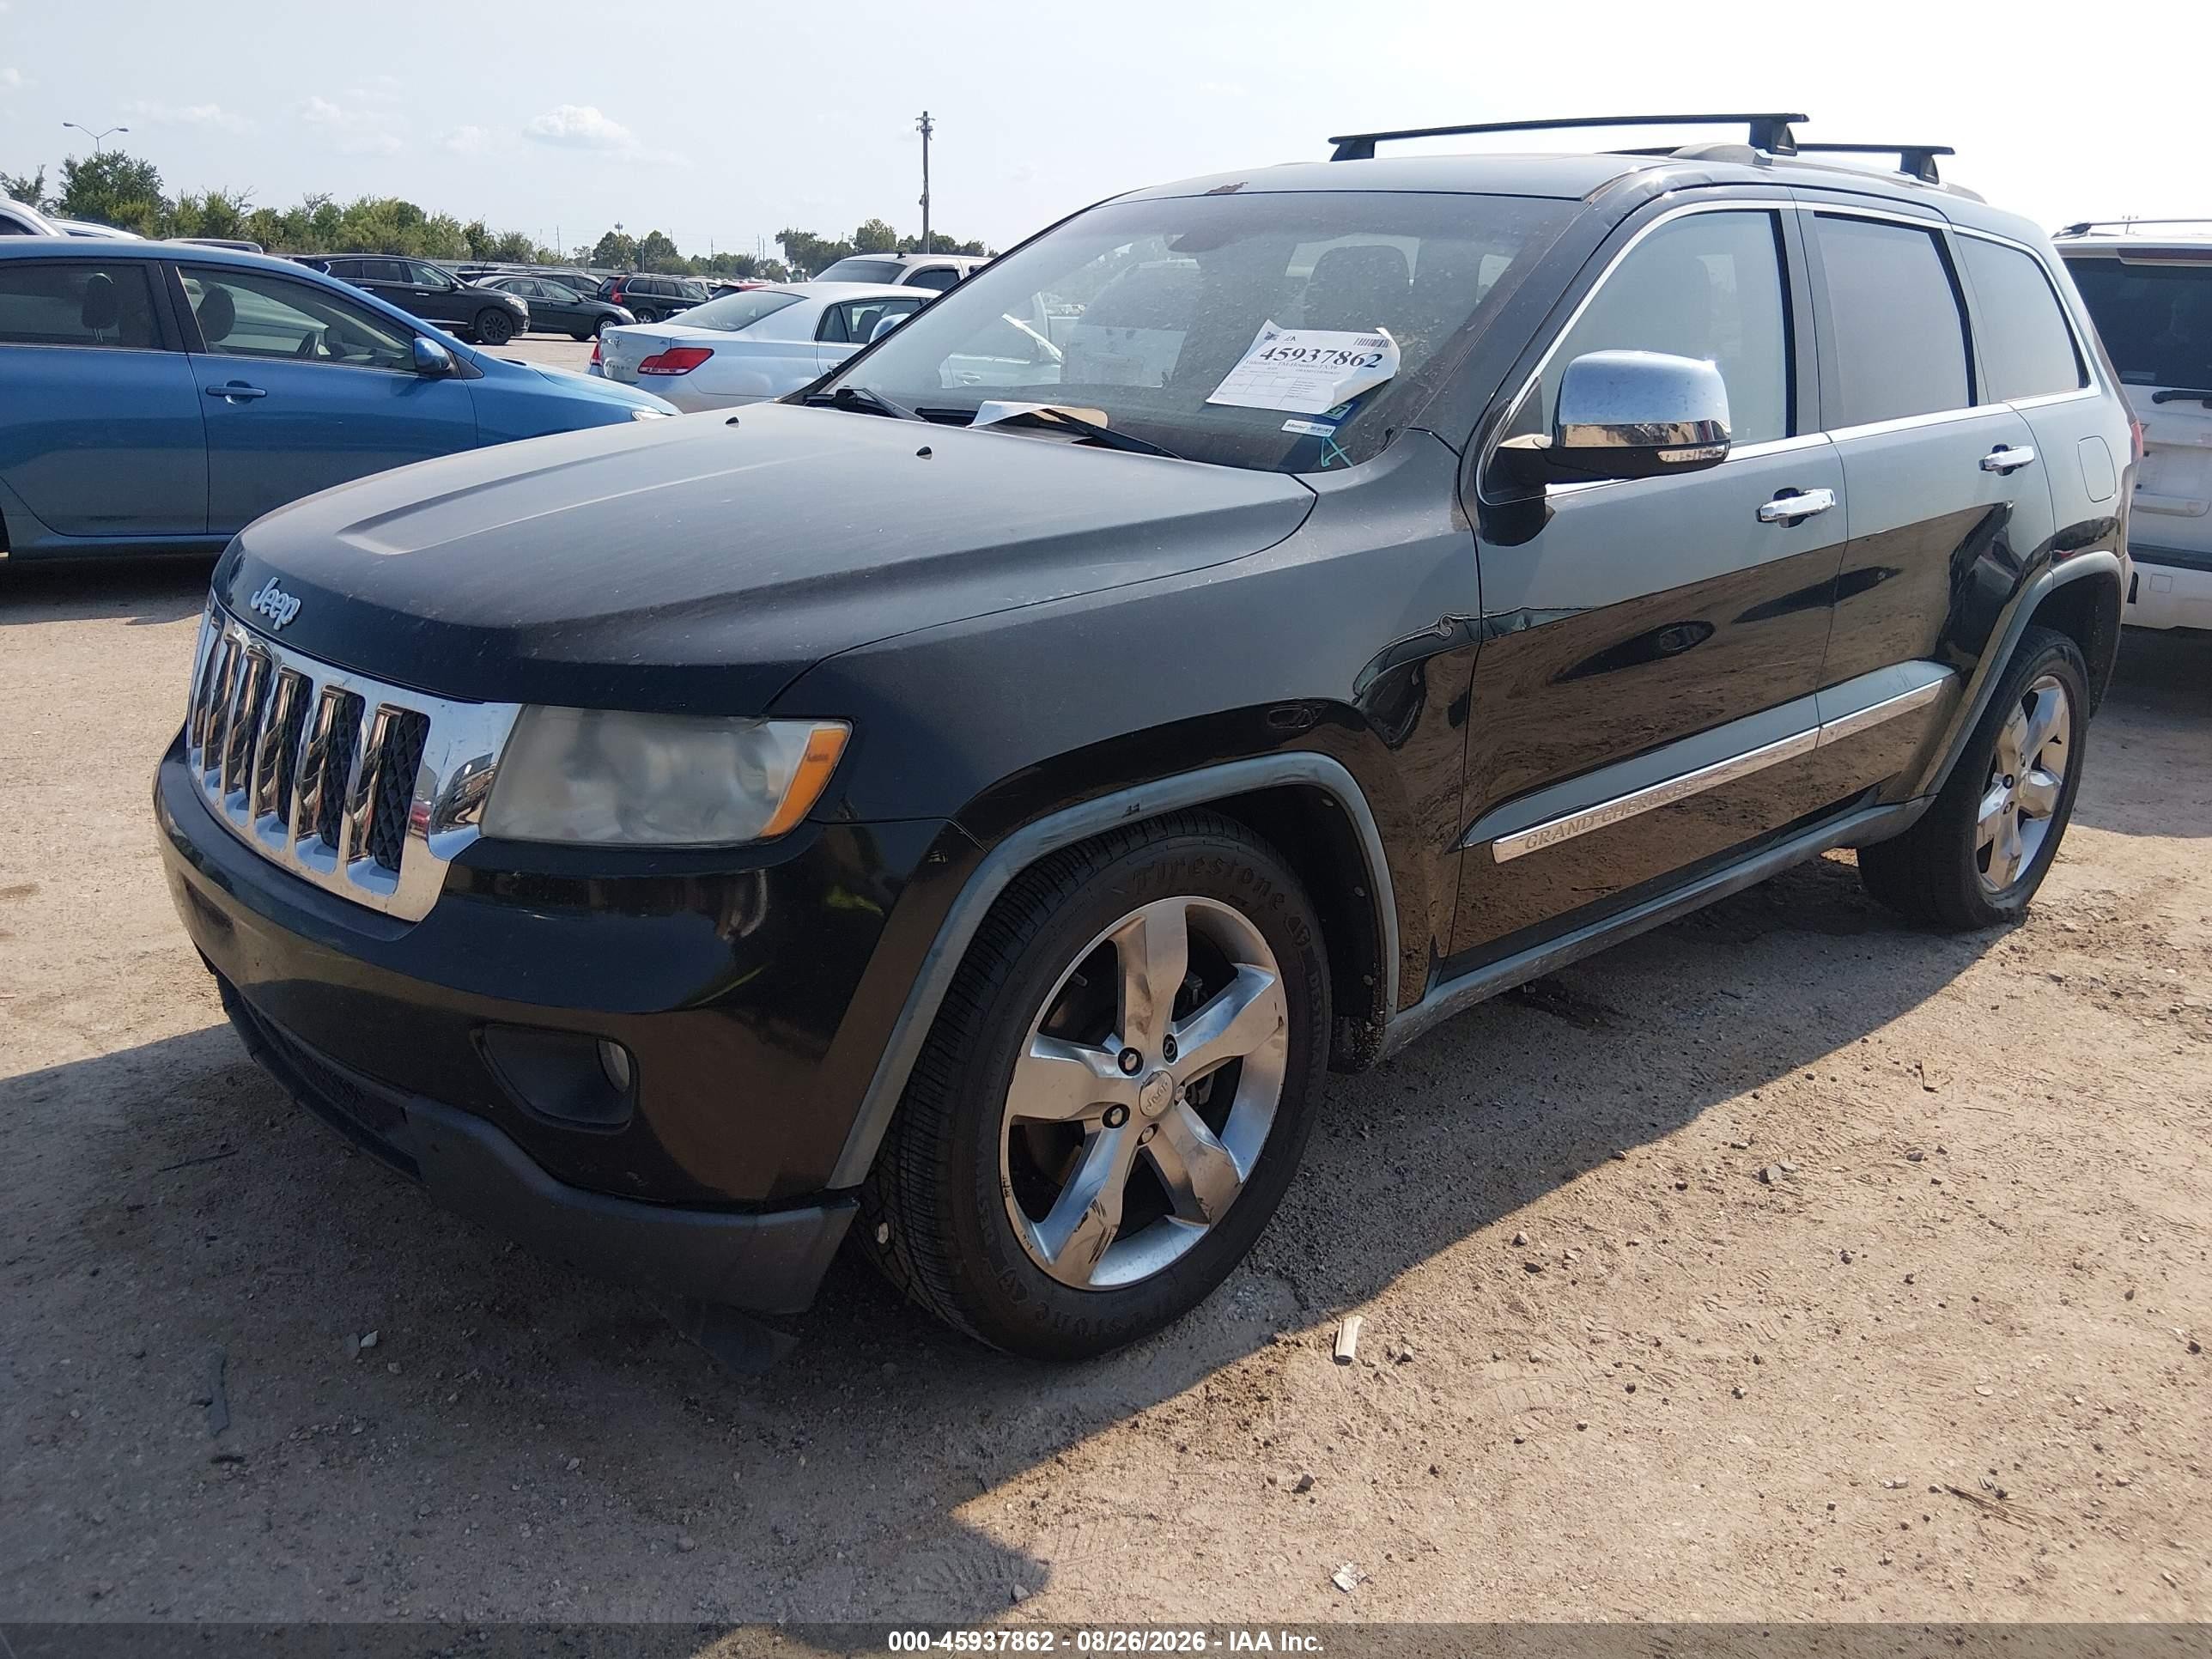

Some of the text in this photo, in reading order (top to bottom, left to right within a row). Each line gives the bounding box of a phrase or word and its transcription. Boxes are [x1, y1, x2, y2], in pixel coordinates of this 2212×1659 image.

[1260, 346, 1383, 368] 45937862
[250, 576, 301, 631] Jeep
[1524, 780, 1696, 849] GRAND CHEROKEE
